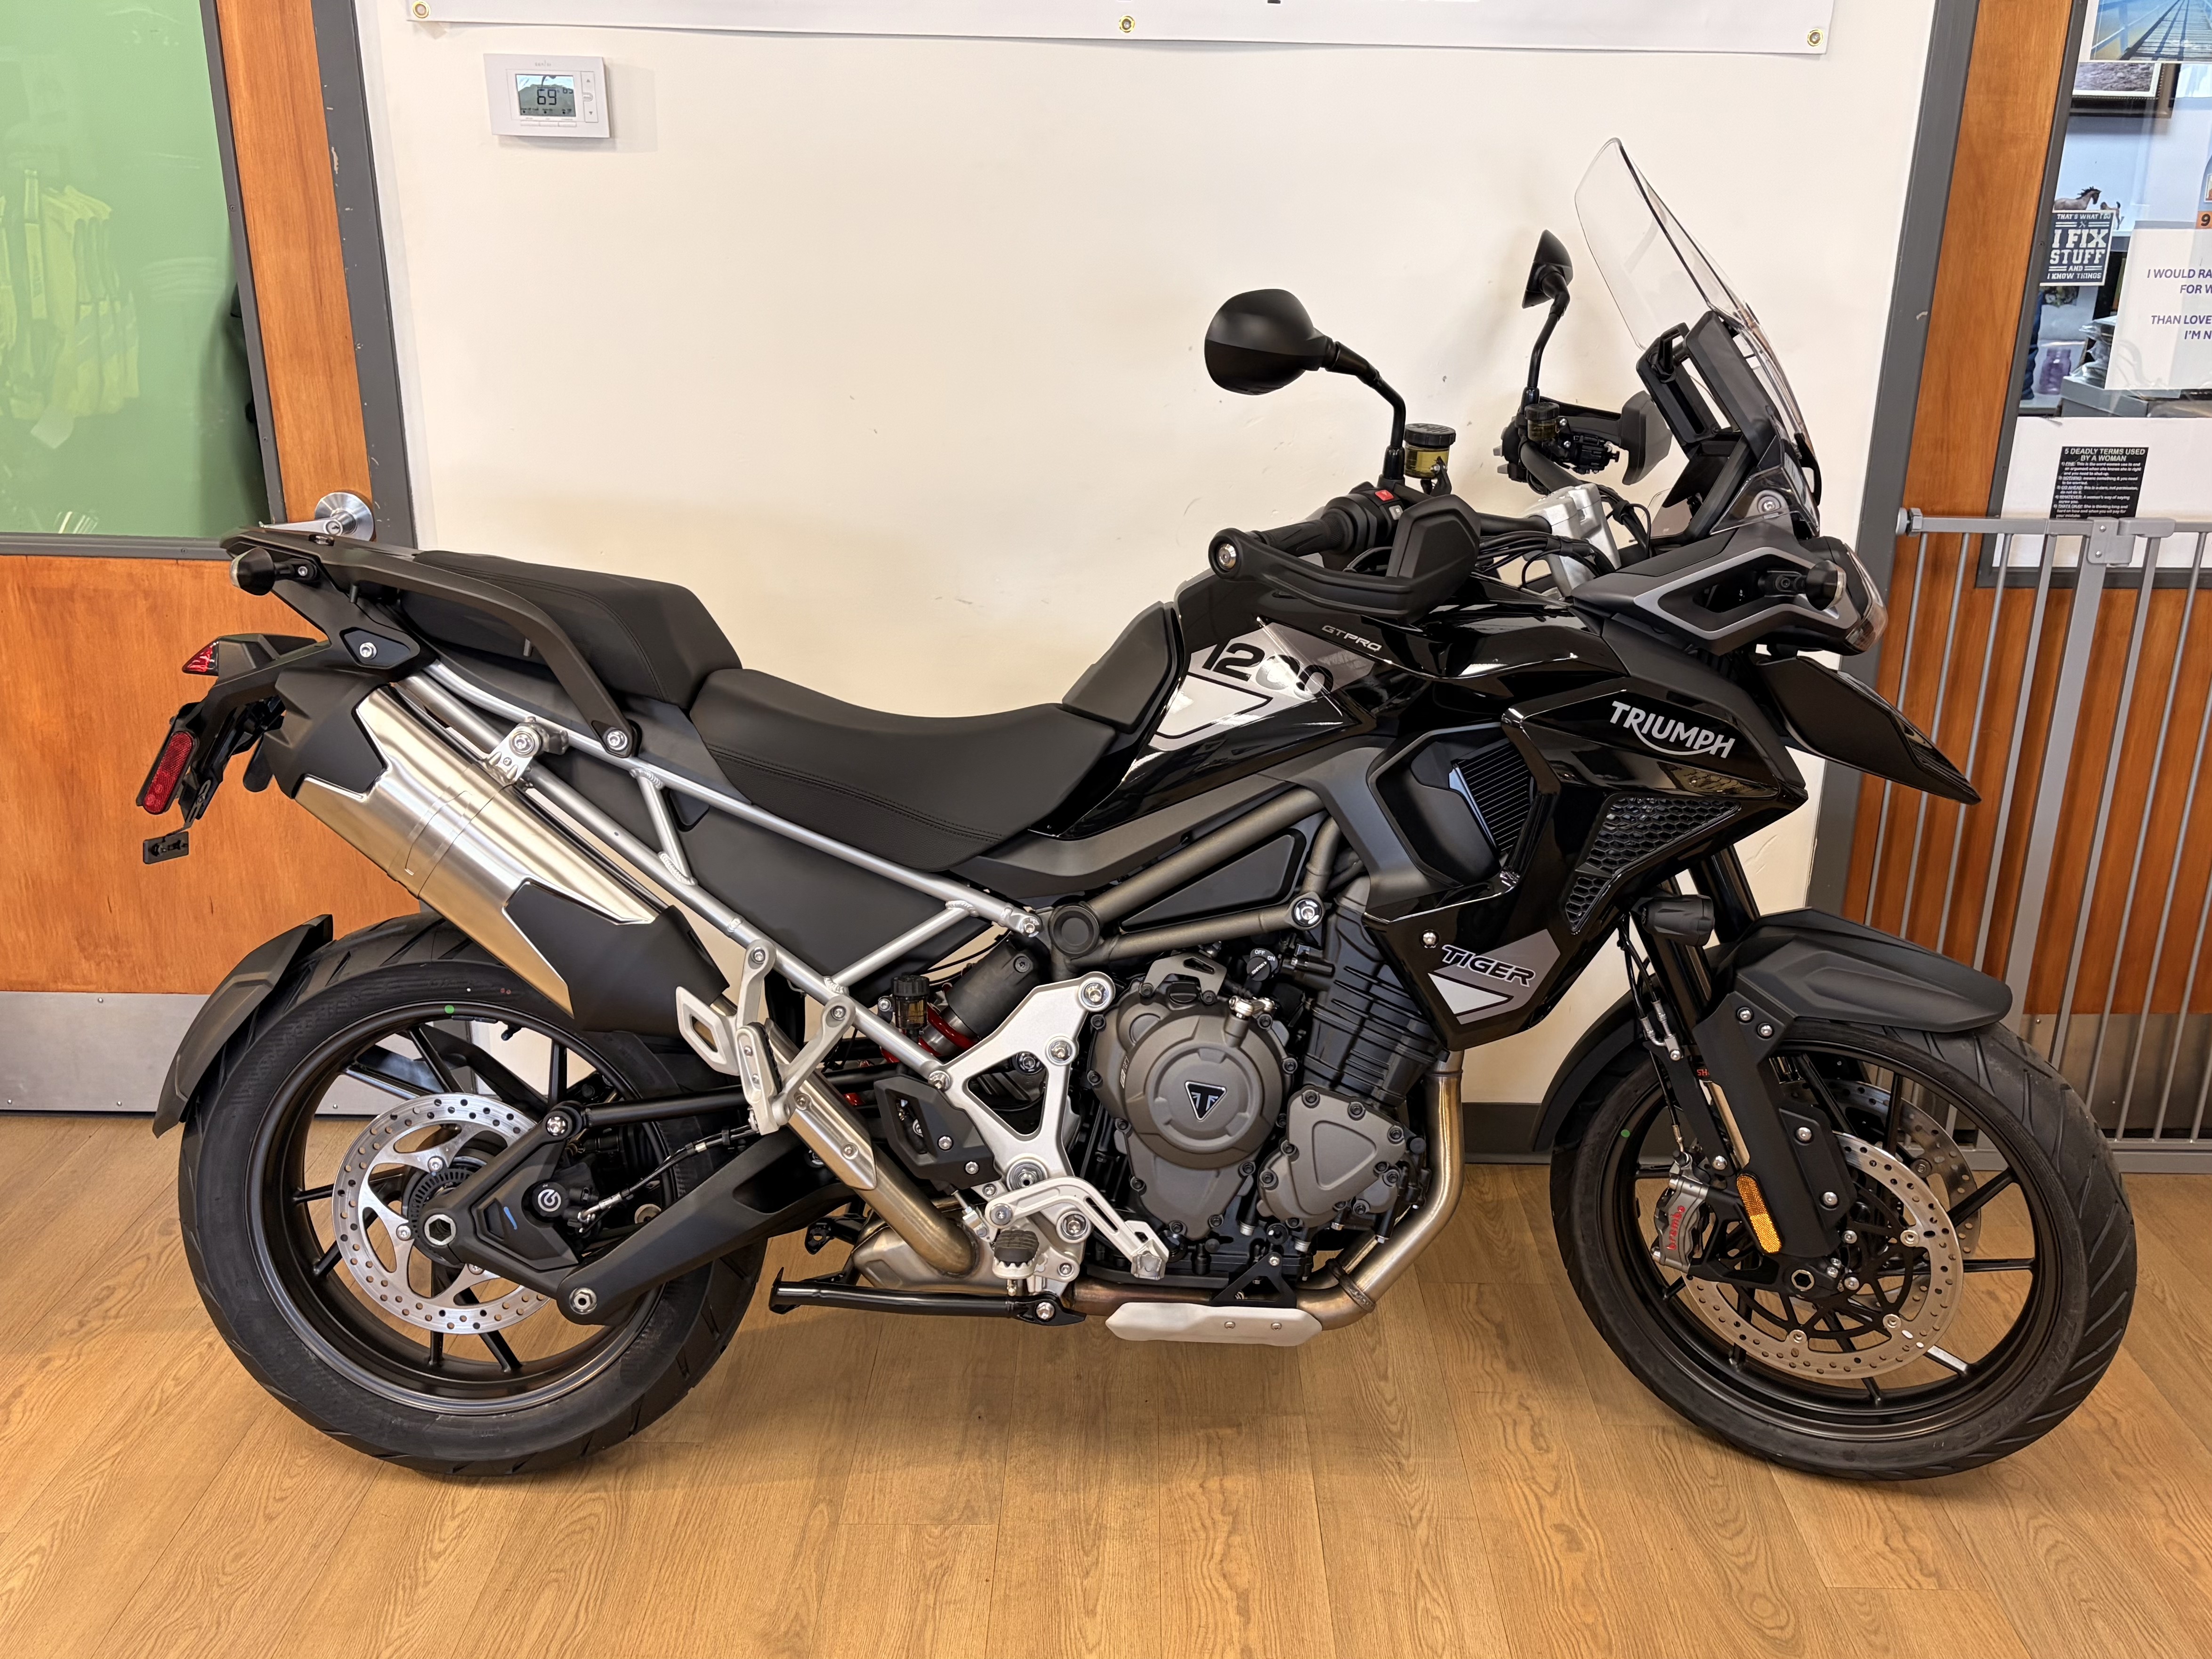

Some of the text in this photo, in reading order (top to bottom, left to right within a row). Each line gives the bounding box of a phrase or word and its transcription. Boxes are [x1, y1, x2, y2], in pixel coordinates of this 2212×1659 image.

[537, 89, 557, 105] 69
[2201, 214, 2211, 226] 9
[2052, 229, 2108, 248] I FIX
[2050, 249, 2106, 264] STUFF
[2147, 269, 2151, 278] I
[2154, 269, 2195, 278] WOULD
[2180, 285, 2202, 294] FOR
[2151, 315, 2181, 324] THAN
[2185, 330, 2200, 339] I'M
[1610, 701, 1736, 758] TRIUMPH
[1442, 944, 1535, 987] TIGER
[1666, 1205, 1686, 1250] brembo
